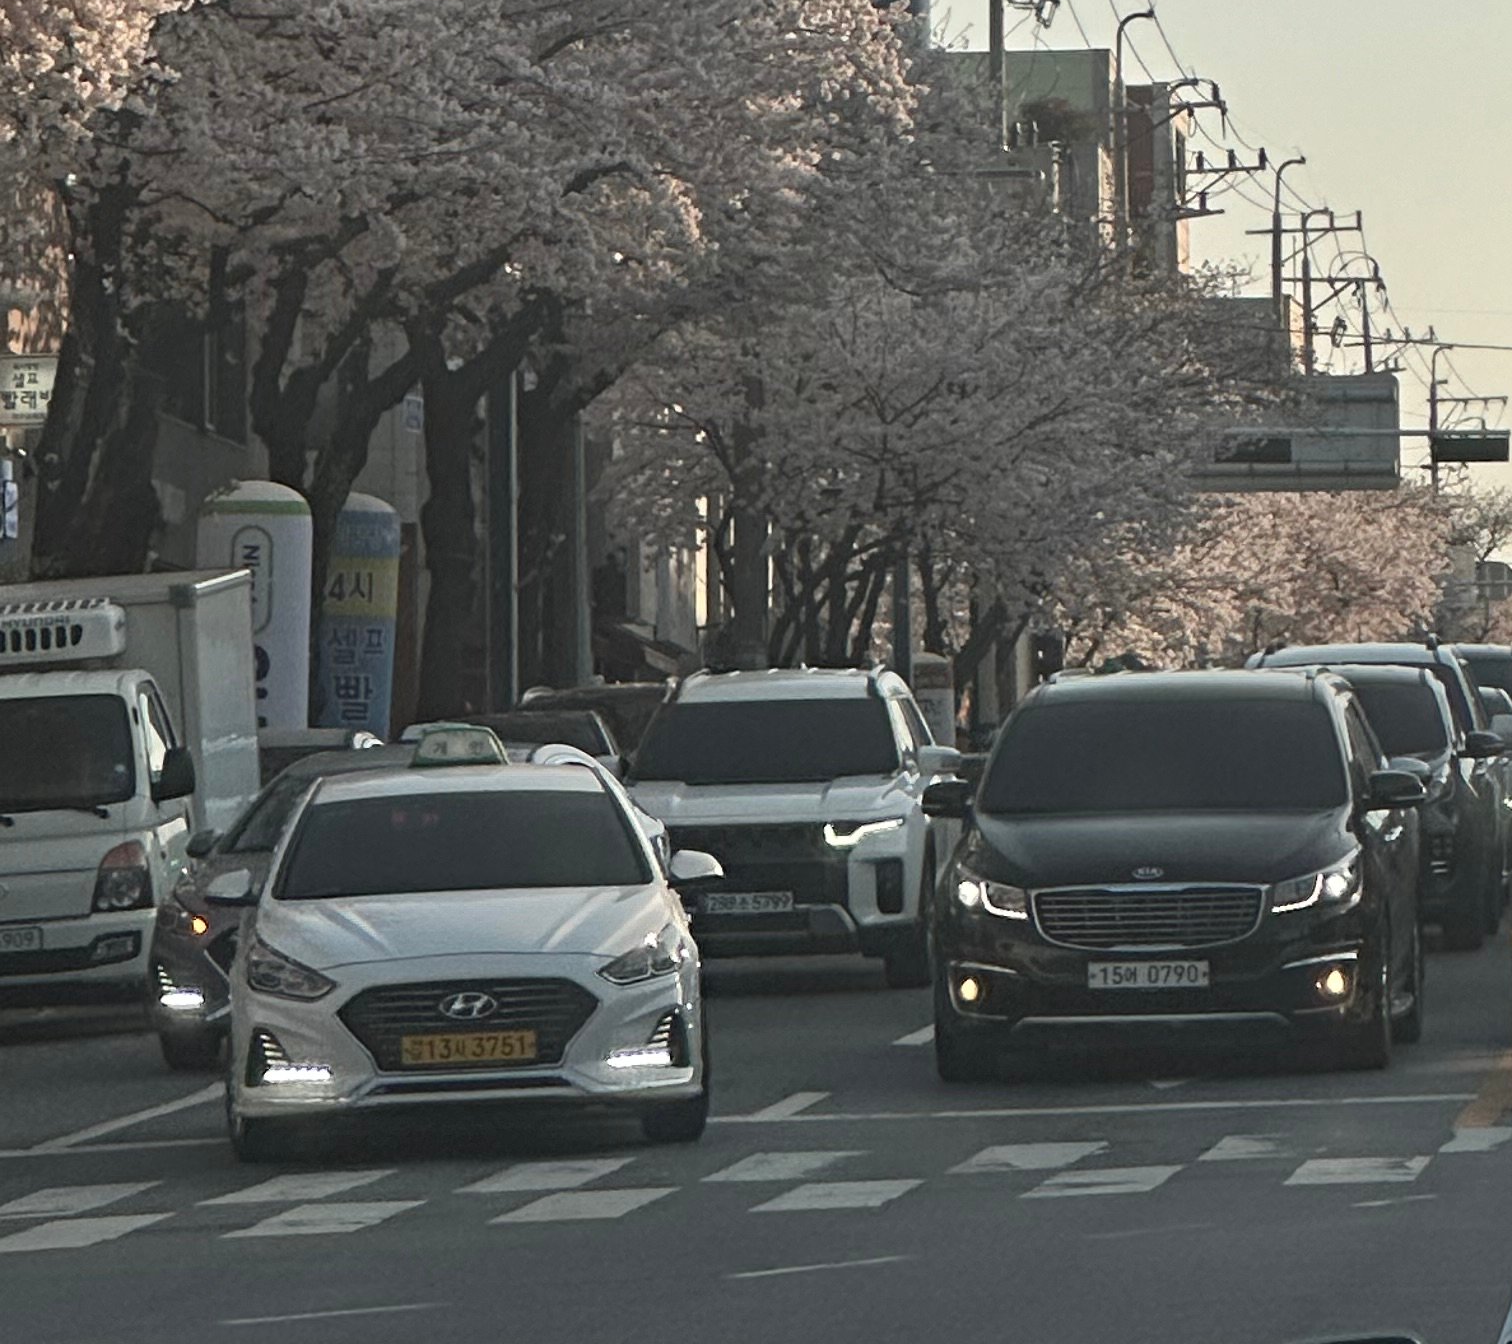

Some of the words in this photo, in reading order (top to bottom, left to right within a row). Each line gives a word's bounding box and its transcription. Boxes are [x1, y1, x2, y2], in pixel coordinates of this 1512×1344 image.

[325, 571, 373, 604] 4시
[0, 931, 35, 949] 909
[1147, 964, 1199, 984] 0790
